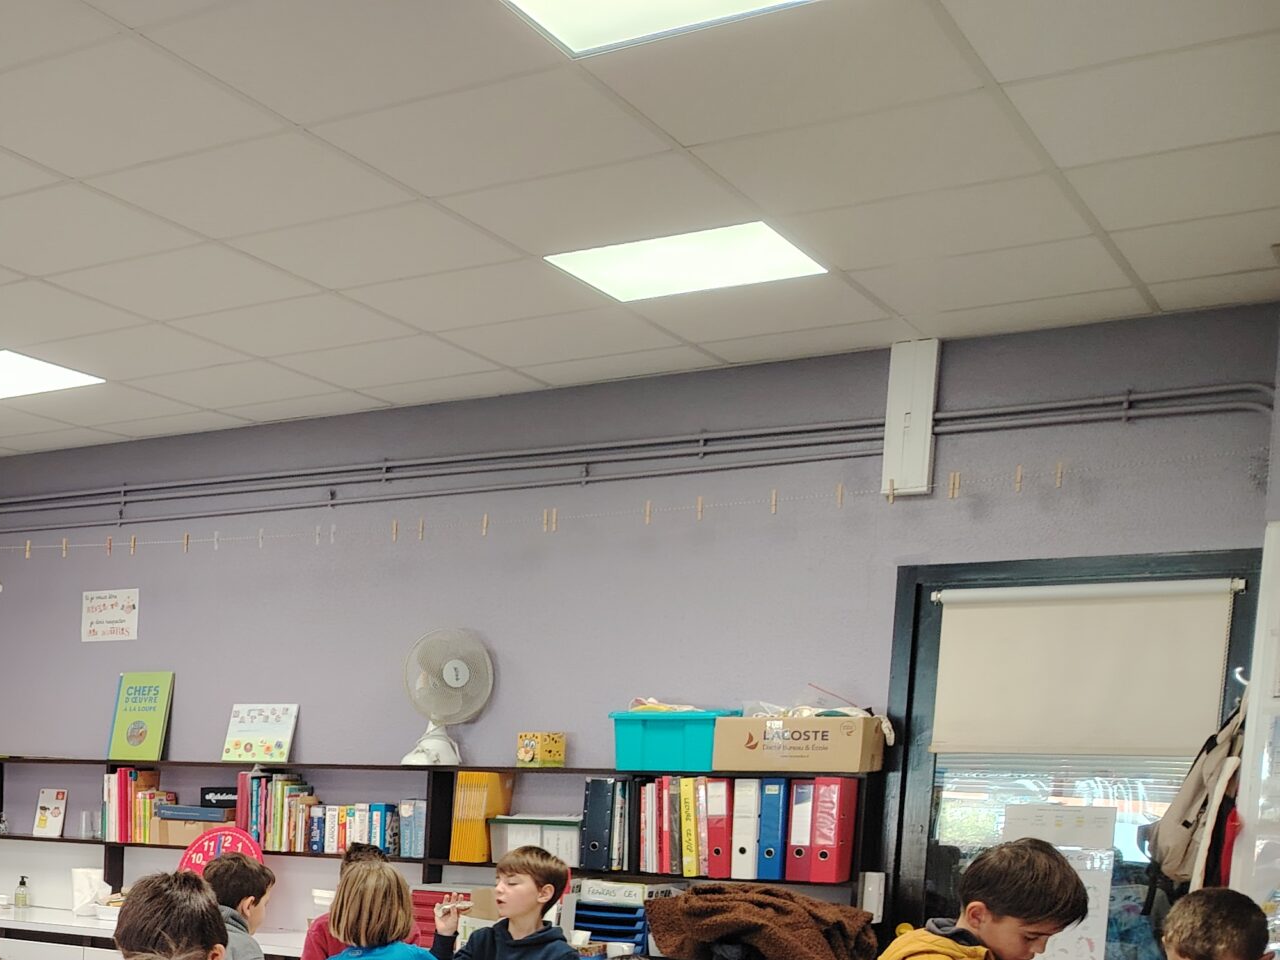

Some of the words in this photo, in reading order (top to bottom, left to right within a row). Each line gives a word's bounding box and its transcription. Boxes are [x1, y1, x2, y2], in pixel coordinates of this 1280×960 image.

[126, 685, 160, 696] CHEFS
[763, 730, 830, 742] LACOSTE
[203, 841, 215, 852] 11
[191, 853, 203, 864] 10
